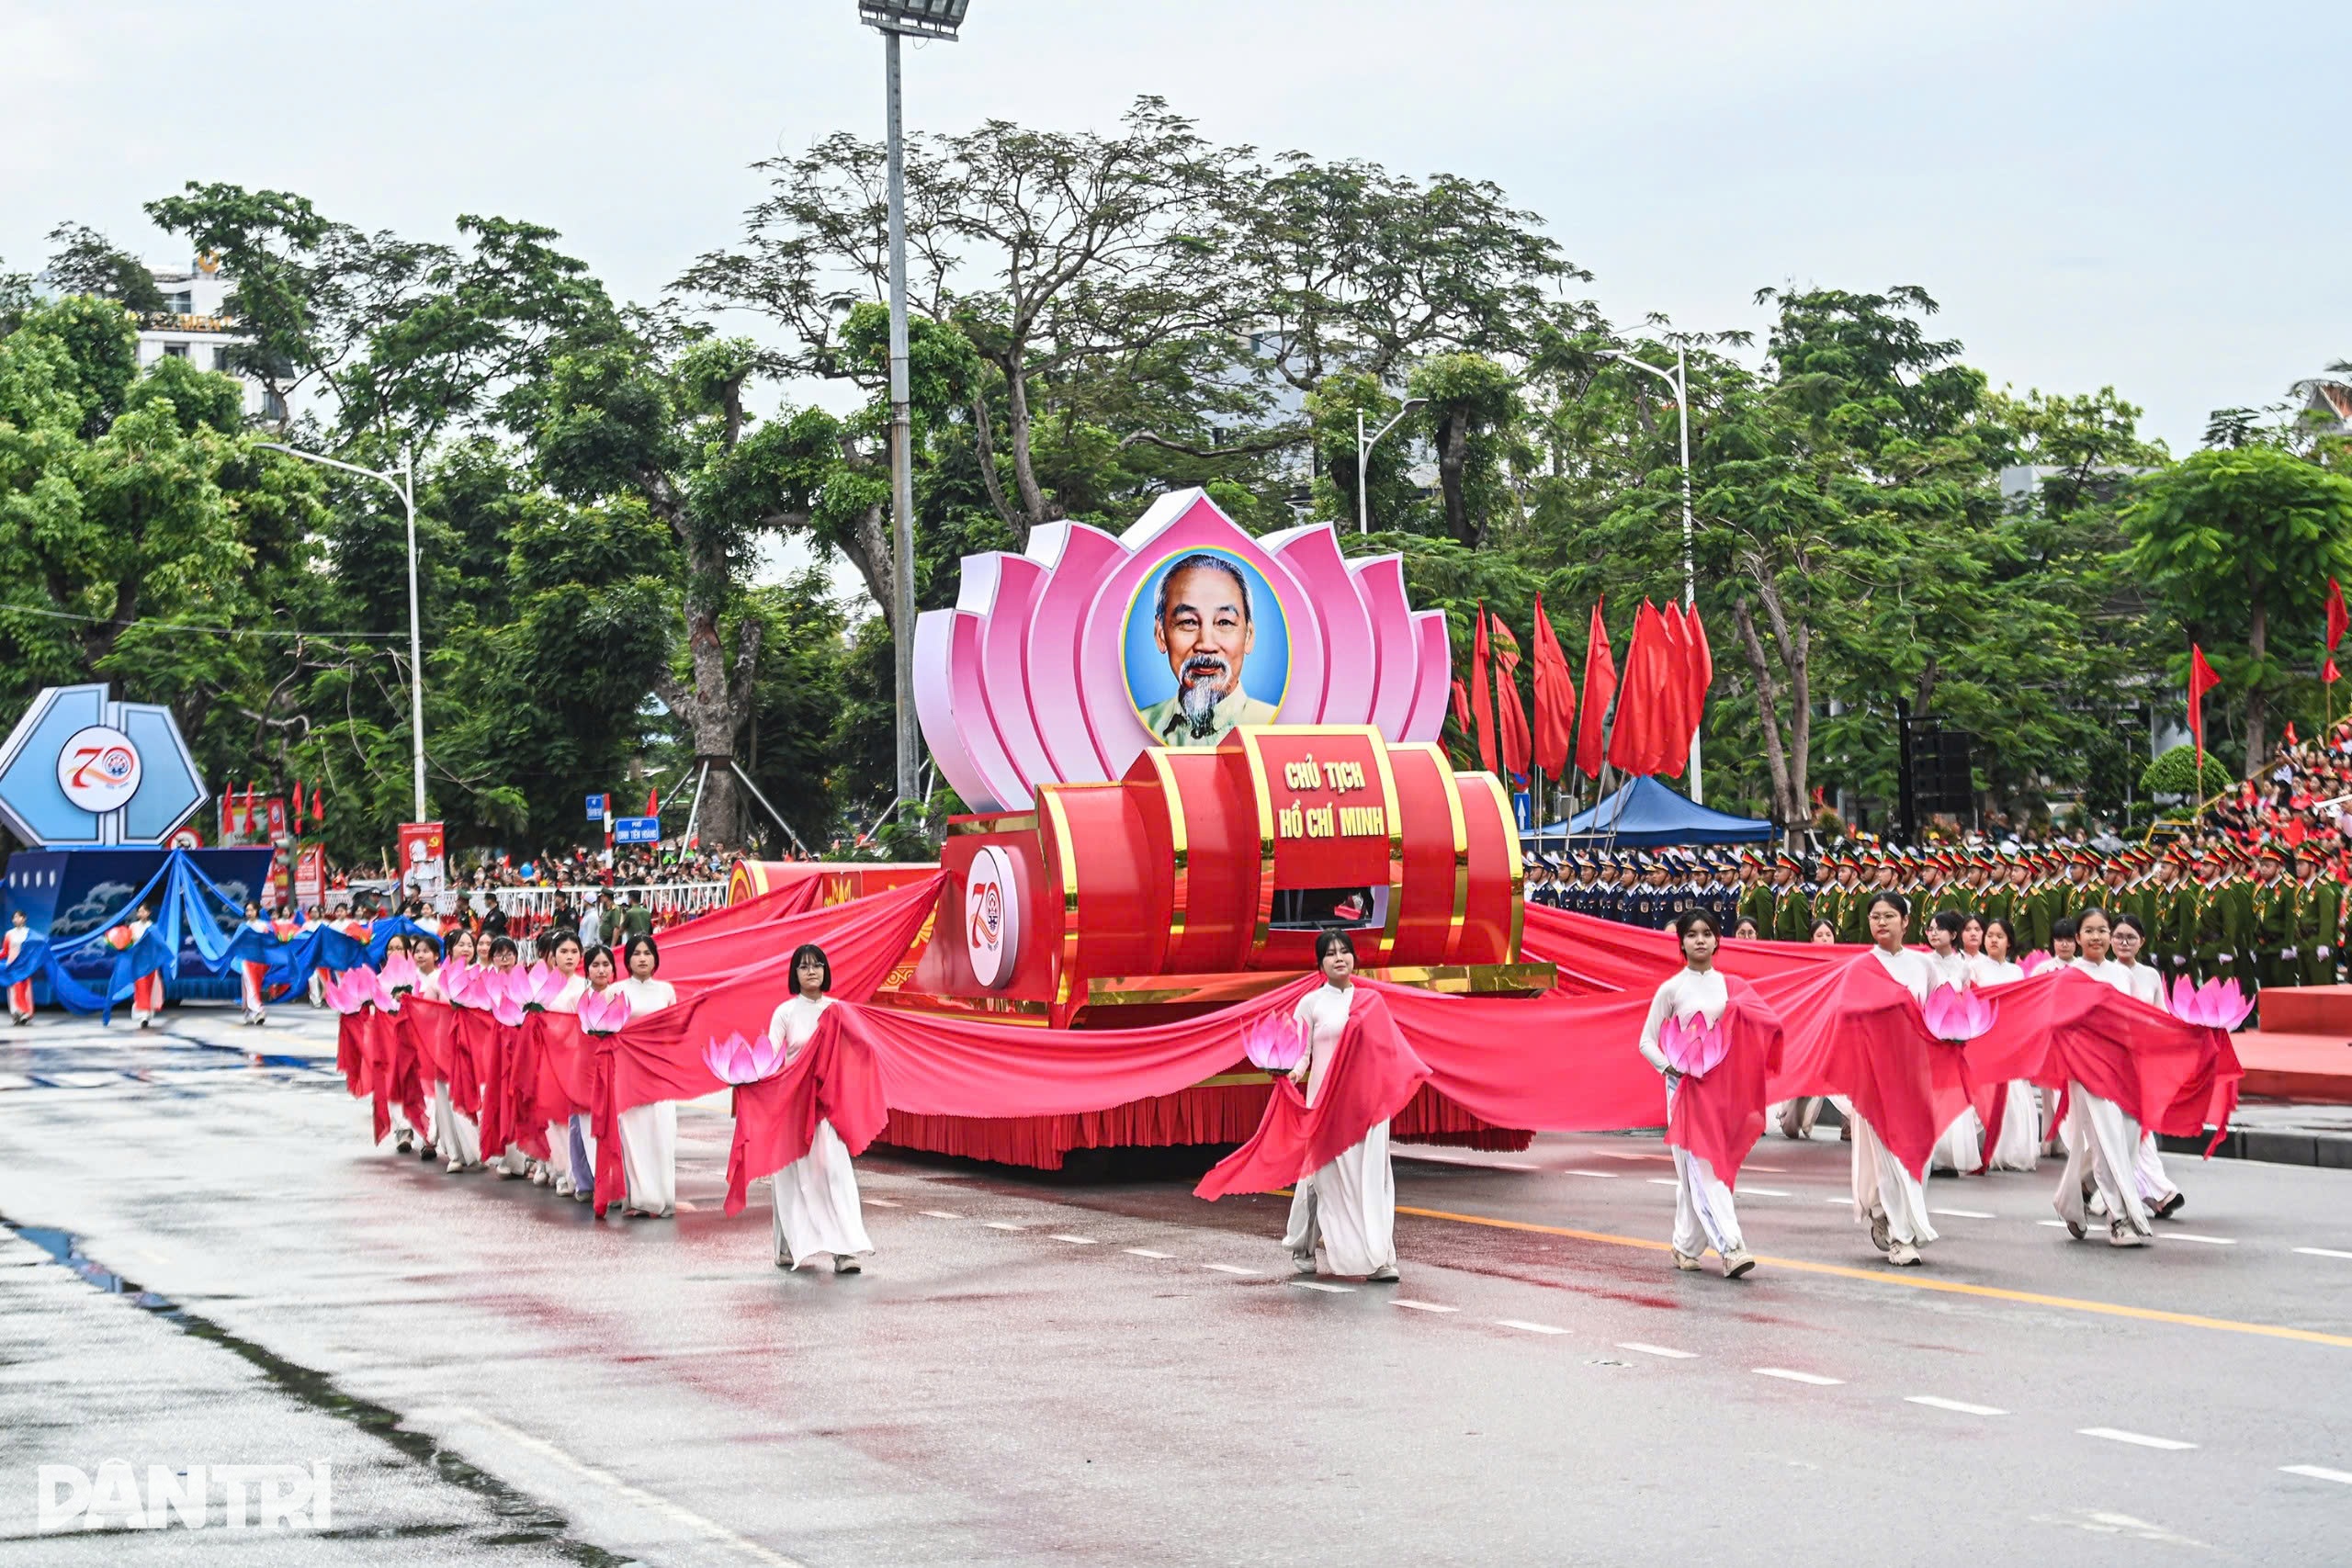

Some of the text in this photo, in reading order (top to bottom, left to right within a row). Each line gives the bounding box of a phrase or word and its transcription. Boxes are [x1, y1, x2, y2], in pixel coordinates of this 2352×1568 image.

[1284, 752, 1366, 795] CHỦ TỊCH
[1278, 798, 1385, 839] HỒ CHÍ MINH
